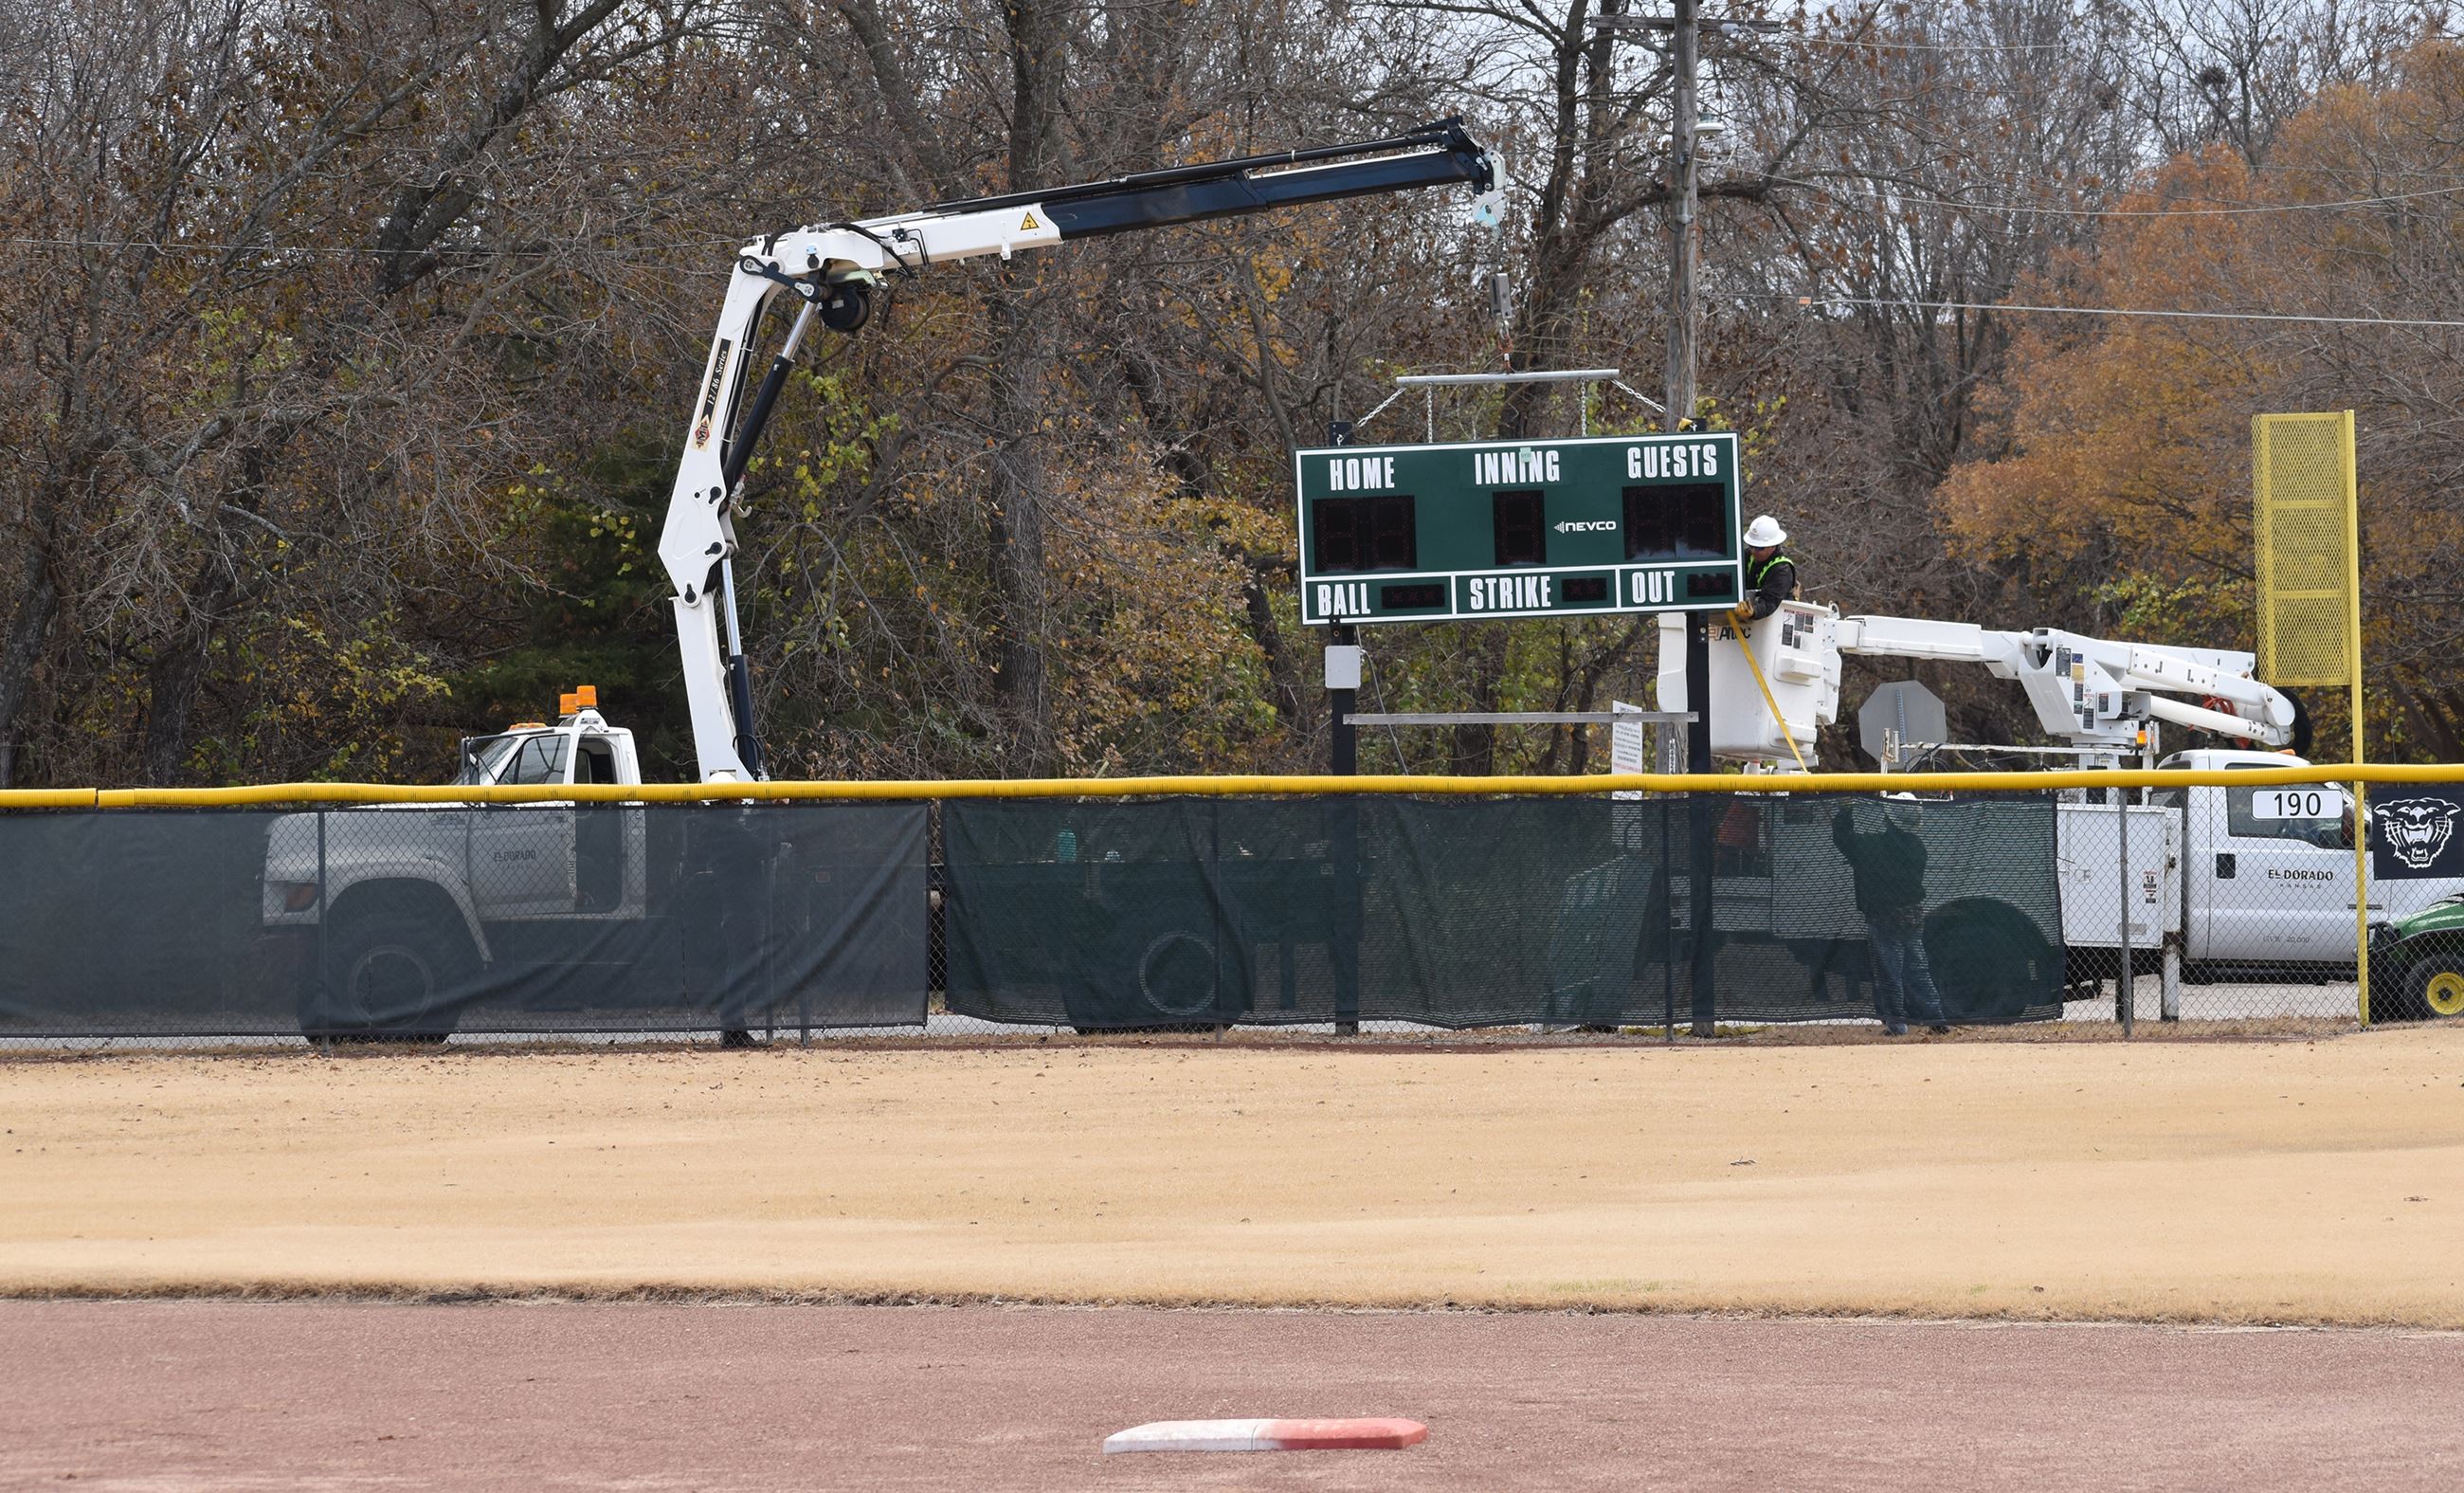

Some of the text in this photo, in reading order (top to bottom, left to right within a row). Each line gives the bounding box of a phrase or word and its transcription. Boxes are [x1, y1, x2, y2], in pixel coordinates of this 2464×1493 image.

[715, 350, 728, 375] Series
[1330, 456, 1395, 491] HOME
[1475, 449, 1560, 485] INNING
[1627, 444, 1718, 480] GUESTS
[1565, 520, 1617, 532] NEVCO
[1317, 583, 1371, 616] BALL
[1470, 575, 1552, 610] STRIKE
[1631, 571, 1676, 604] OUT
[2274, 792, 2321, 816] 190
[2268, 869, 2333, 881] EL DORADO
